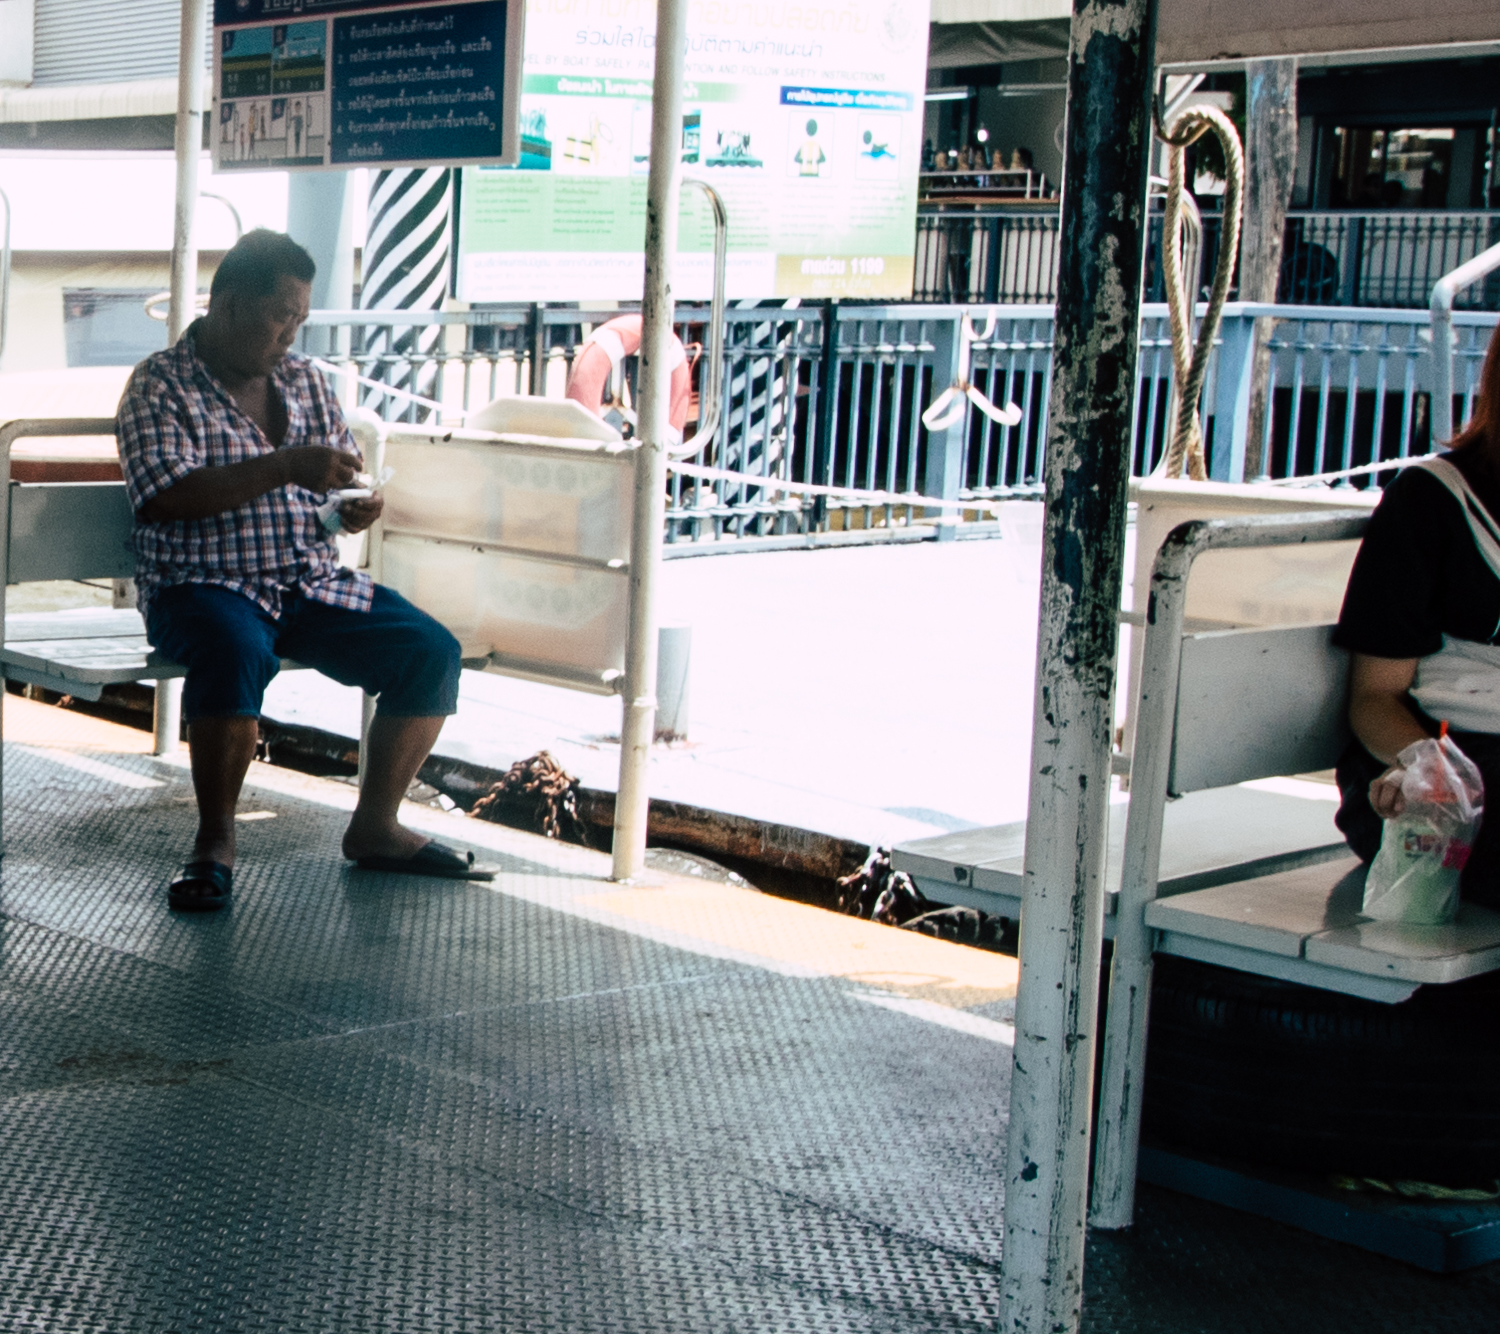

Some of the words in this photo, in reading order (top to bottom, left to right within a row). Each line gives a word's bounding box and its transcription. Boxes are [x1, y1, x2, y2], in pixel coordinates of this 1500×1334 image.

[545, 54, 558, 64] BY
[563, 55, 590, 66] BOAT
[638, 60, 651, 69] PA
[719, 65, 738, 75] AND
[742, 65, 780, 76] FOLLOW
[784, 67, 817, 79] SAFETY
[821, 70, 886, 82] INSTRUCTIONS
[801, 255, 846, 275] สายด่วน
[850, 256, 884, 276] 1199
